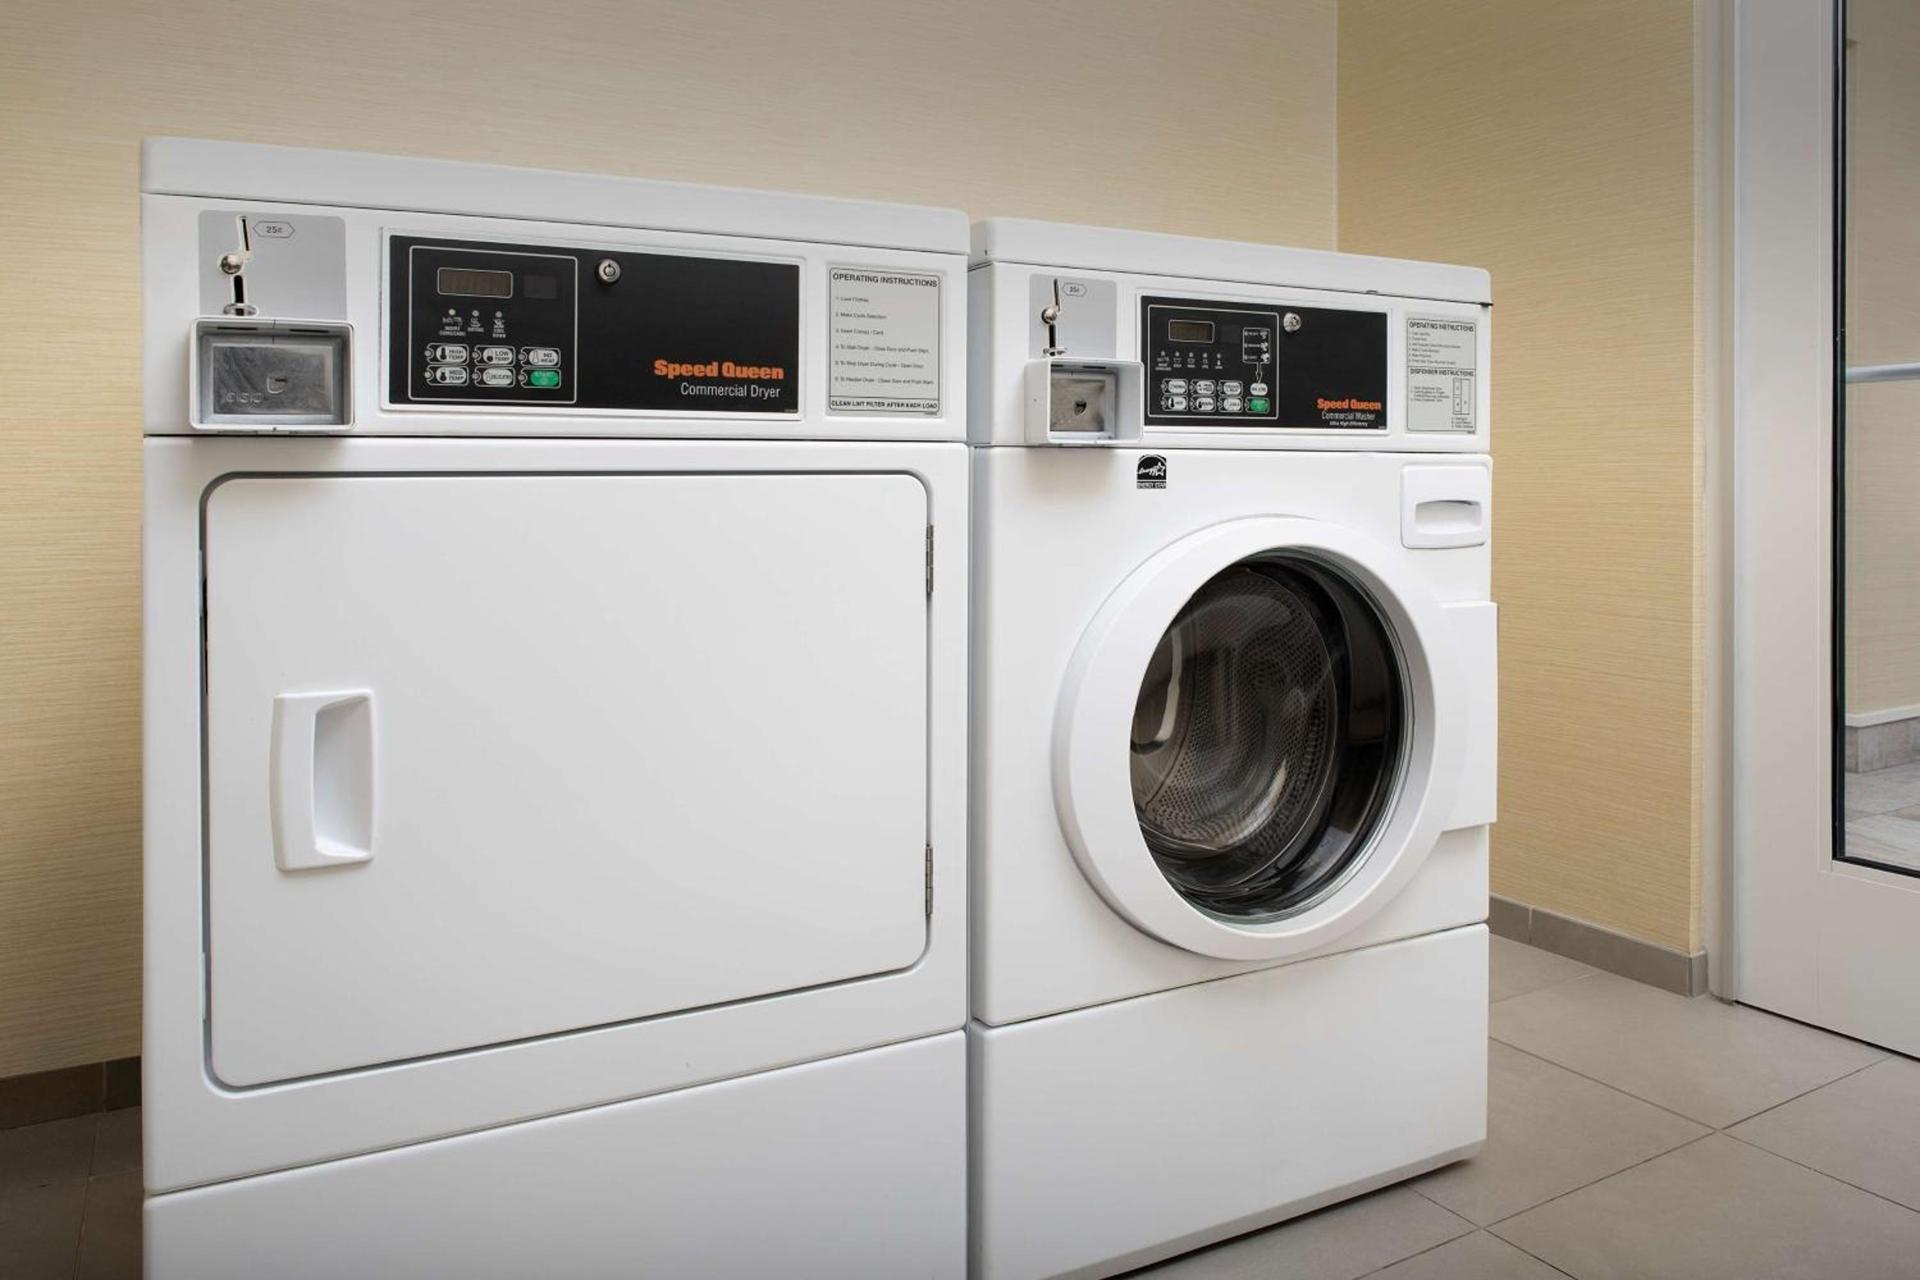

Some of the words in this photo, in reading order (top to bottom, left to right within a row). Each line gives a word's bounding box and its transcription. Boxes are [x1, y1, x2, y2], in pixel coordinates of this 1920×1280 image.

[833, 272, 879, 283] OPERATING
[880, 276, 938, 287] INSTRUCTIONS
[654, 359, 719, 379] Speed
[721, 361, 784, 379] Queen
[680, 382, 747, 397] Commercial
[750, 384, 780, 400] Dryer
[1317, 398, 1349, 410] Speed
[1350, 399, 1381, 410] Queen
[1321, 411, 1354, 420] Commercial
[1355, 411, 1375, 420] Washer
